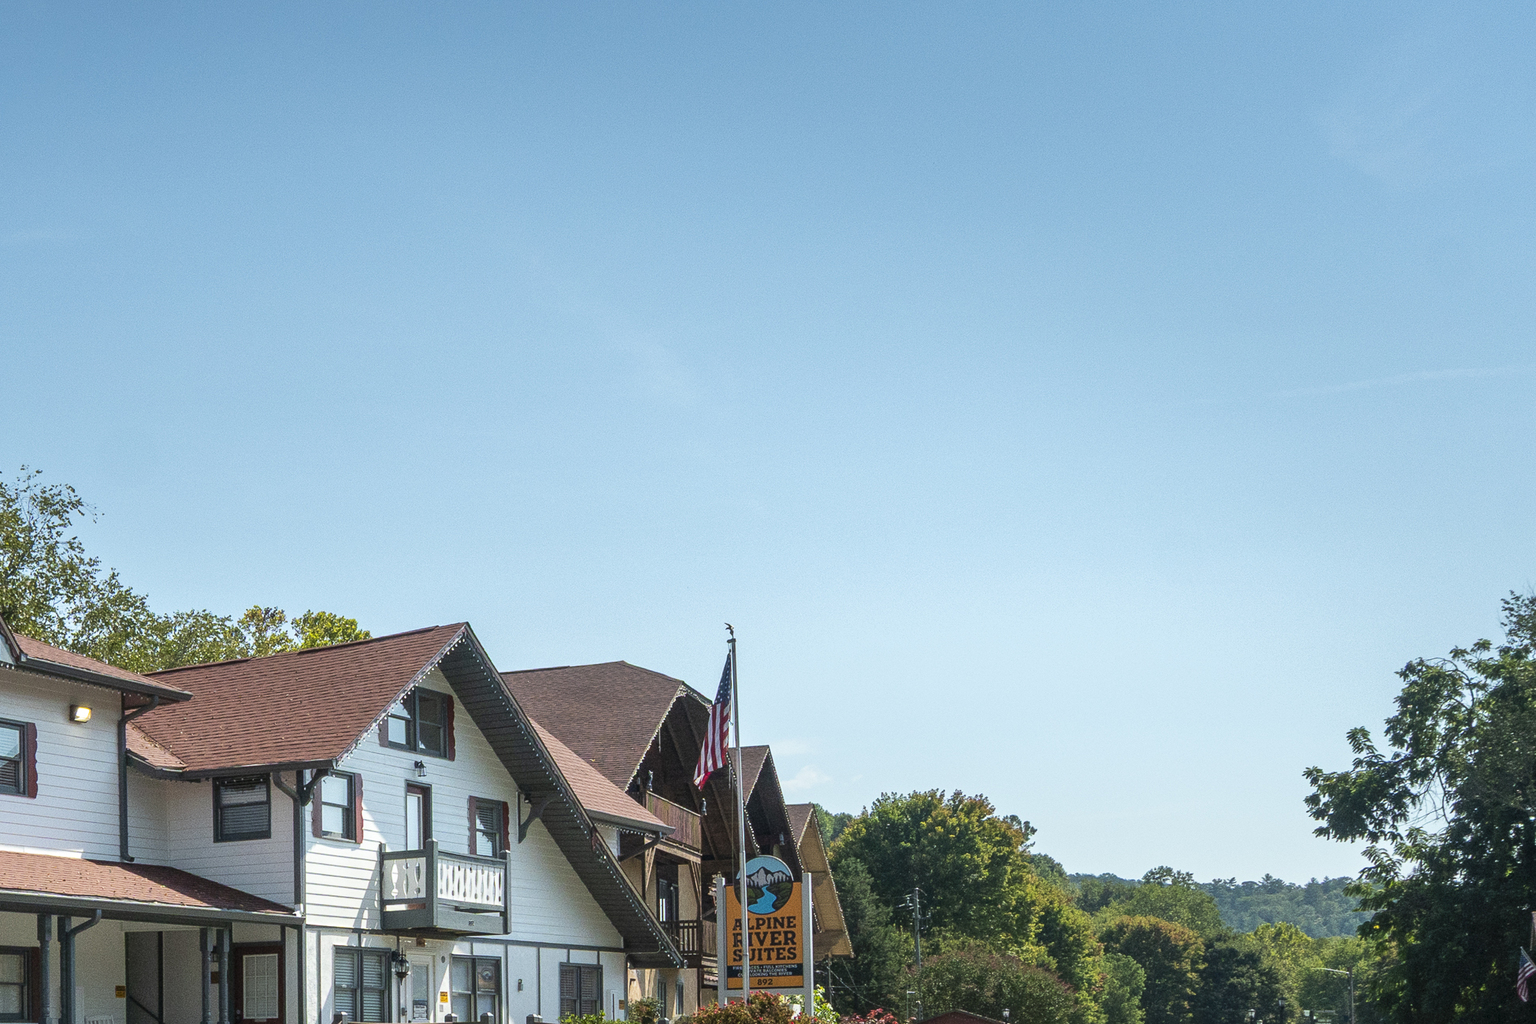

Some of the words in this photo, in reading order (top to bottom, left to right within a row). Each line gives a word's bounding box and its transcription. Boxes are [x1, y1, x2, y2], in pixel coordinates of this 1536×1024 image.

[732, 916, 796, 931] ALPINE
[732, 930, 797, 947] RIVER
[733, 947, 797, 962] SUITES
